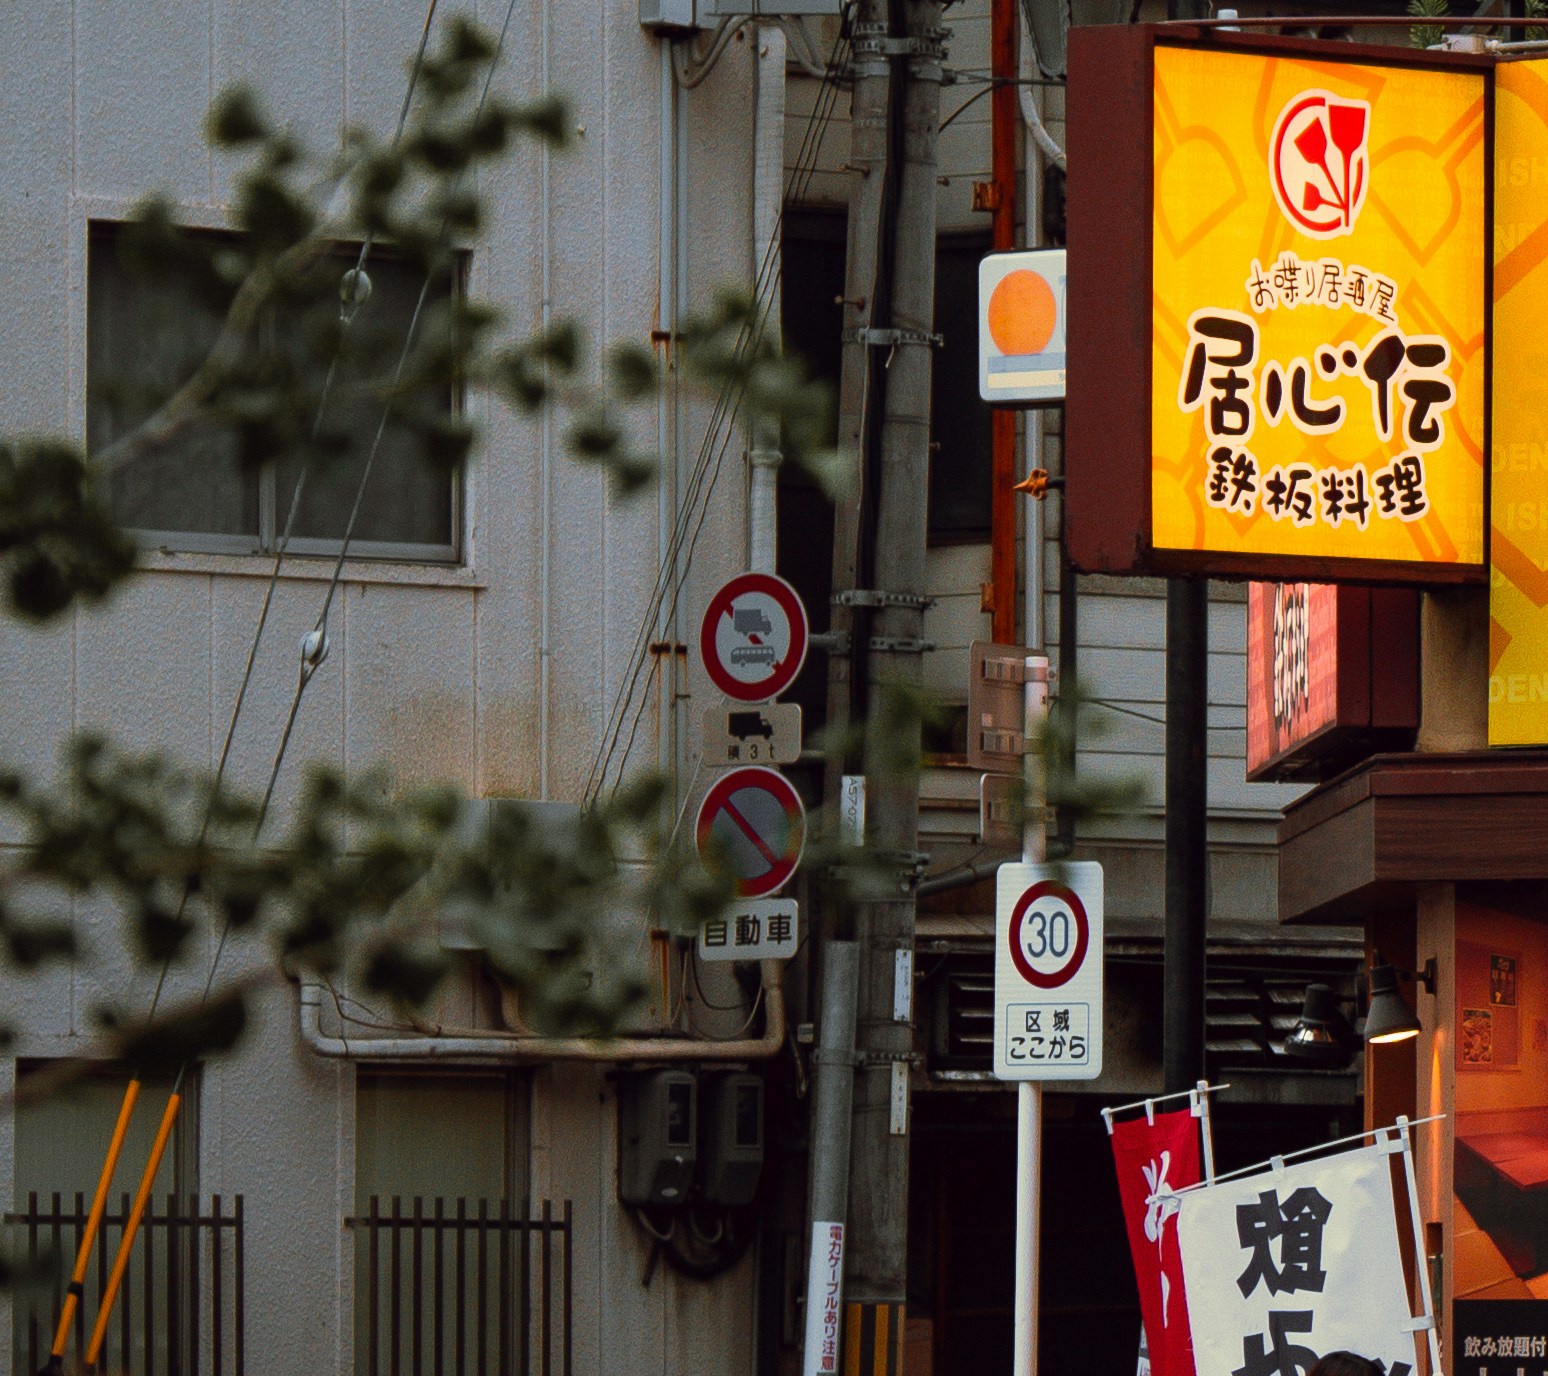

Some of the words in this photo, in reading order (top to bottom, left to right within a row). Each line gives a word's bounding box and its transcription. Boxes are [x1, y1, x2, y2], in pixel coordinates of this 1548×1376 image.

[1184, 316, 1453, 444] 居心伝
[1209, 448, 1425, 526] 鉄板料理
[705, 913, 792, 947] 自動車
[1027, 911, 1069, 957] 30
[1025, 1008, 1070, 1032] 区域
[1010, 1036, 1086, 1059] ここから
[1464, 1335, 1546, 1358] 飲み放題付
